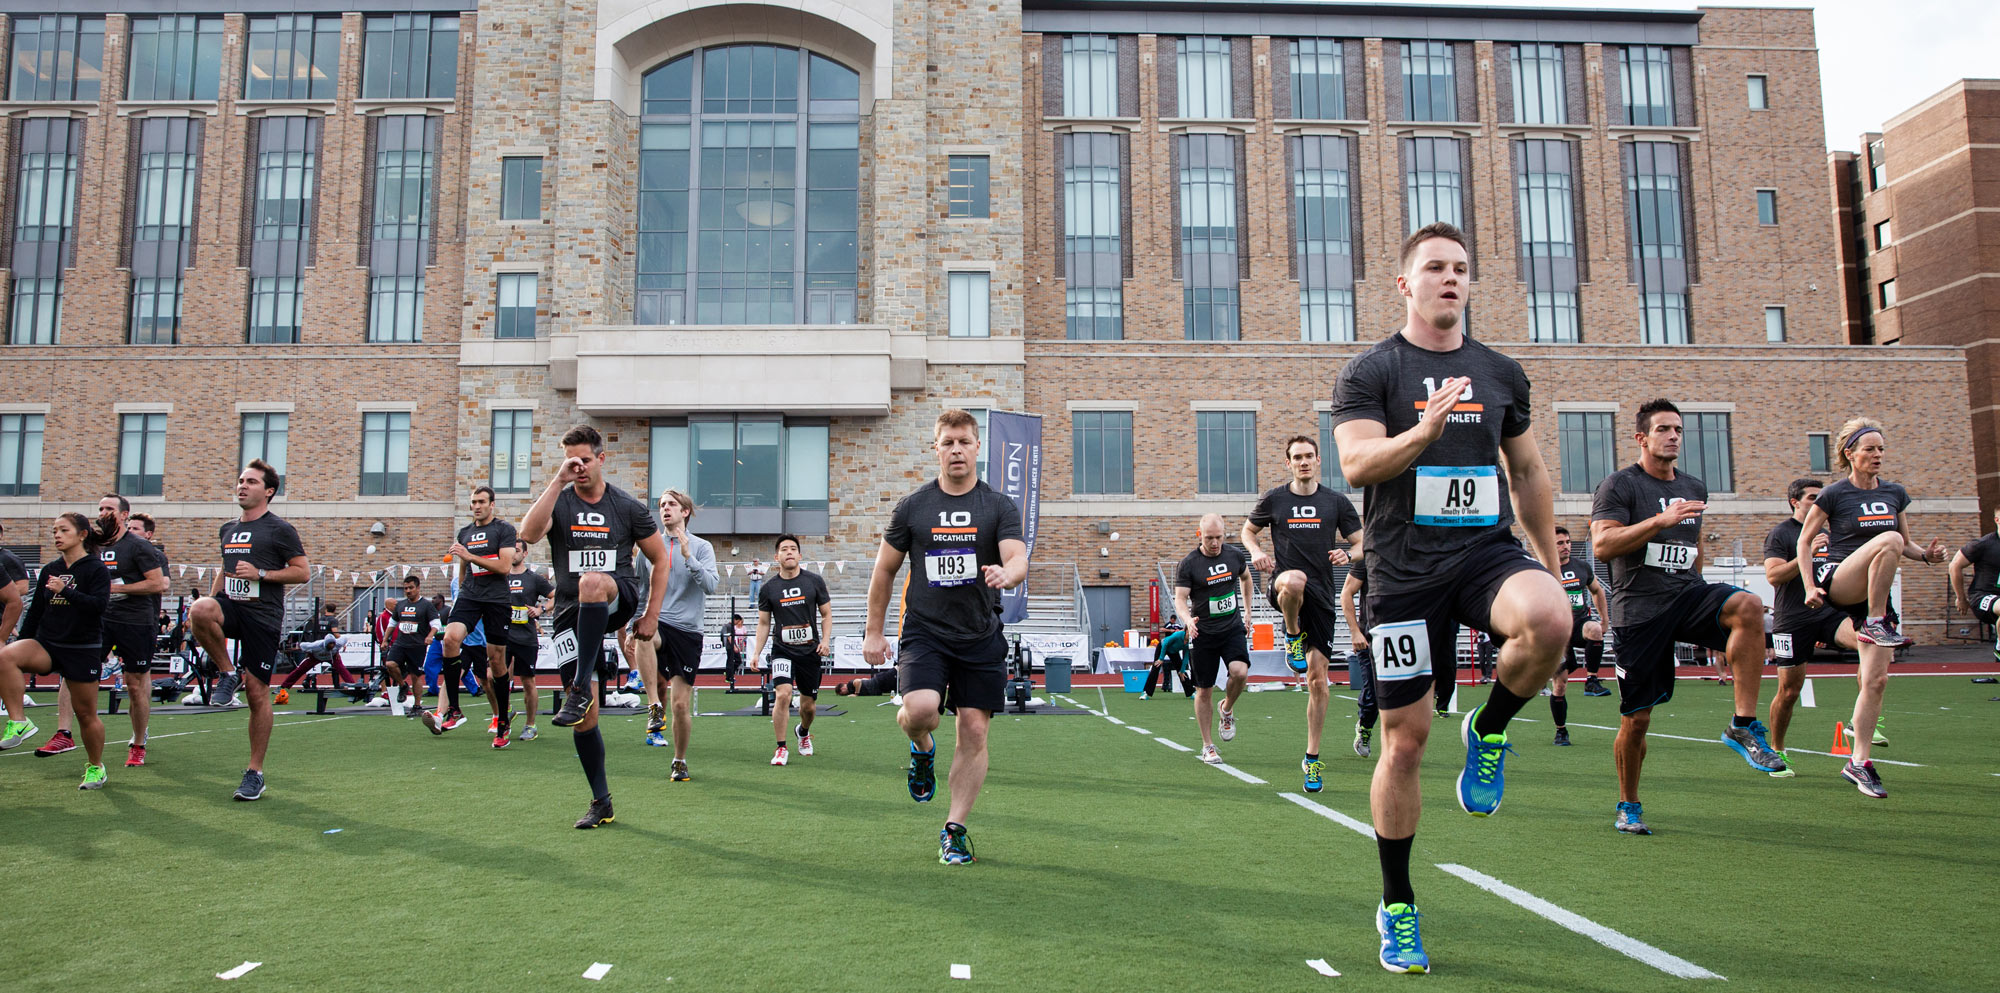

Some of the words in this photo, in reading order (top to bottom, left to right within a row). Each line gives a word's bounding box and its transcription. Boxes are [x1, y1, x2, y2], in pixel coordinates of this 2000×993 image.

[1418, 412, 1482, 423] DTHLETE
[1446, 478, 1476, 508] A9
[1291, 506, 1317, 518] 10
[1441, 507, 1460, 516] Timothy
[1860, 502, 1889, 516] 10
[576, 512, 605, 526] 10
[938, 511, 971, 527] 10
[1433, 516, 1460, 524] Southwest
[230, 532, 252, 544] 10
[471, 532, 486, 542] 10
[572, 531, 608, 539] DECATHLETE
[933, 534, 976, 542] DECATHLETE
[579, 551, 606, 567] J119
[1658, 545, 1688, 565] J113
[938, 556, 965, 576] H93
[1208, 563, 1228, 576] 10
[1207, 576, 1232, 586] DECATHLETE
[782, 587, 801, 599] 10
[1569, 594, 1579, 604] 32
[1217, 598, 1232, 611] C36
[1383, 634, 1417, 669] A9
